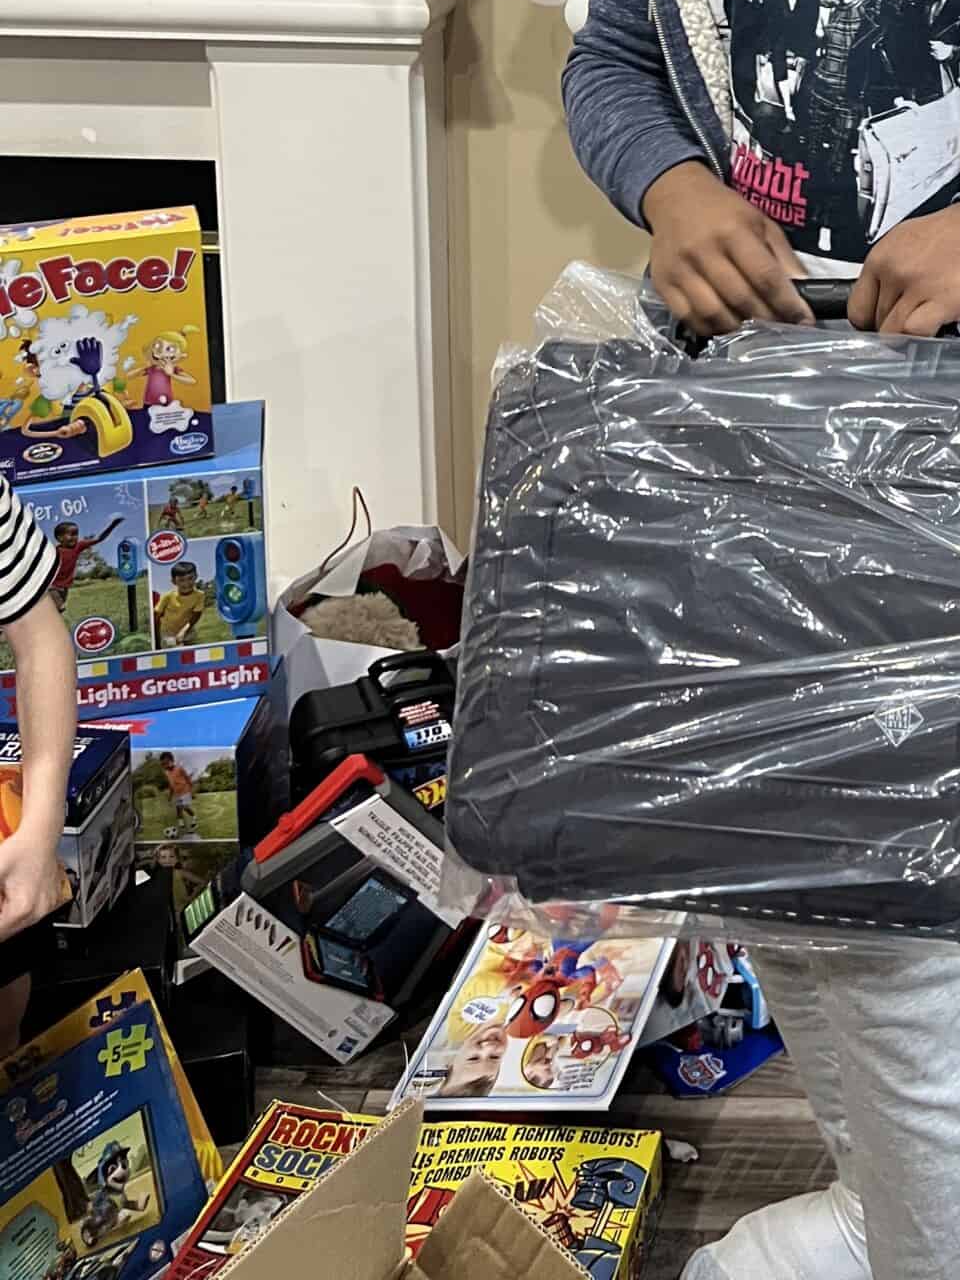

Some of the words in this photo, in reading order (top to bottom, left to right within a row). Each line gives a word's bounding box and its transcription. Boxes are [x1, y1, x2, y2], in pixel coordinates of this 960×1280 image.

[39, 248, 196, 304] Face!
[141, 674, 201, 696] Green
[208, 665, 261, 690] Light
[111, 1045, 121, 1062] 5
[420, 1127, 445, 1147] THE
[446, 1126, 508, 1145] ORIGINAL
[512, 1126, 576, 1143] FIGHTING
[580, 1128, 642, 1149] ROBOTS!
[437, 1146, 506, 1166] PREMIERS
[509, 1147, 566, 1162] ROBOTS
[423, 1164, 486, 1184] COMBA
